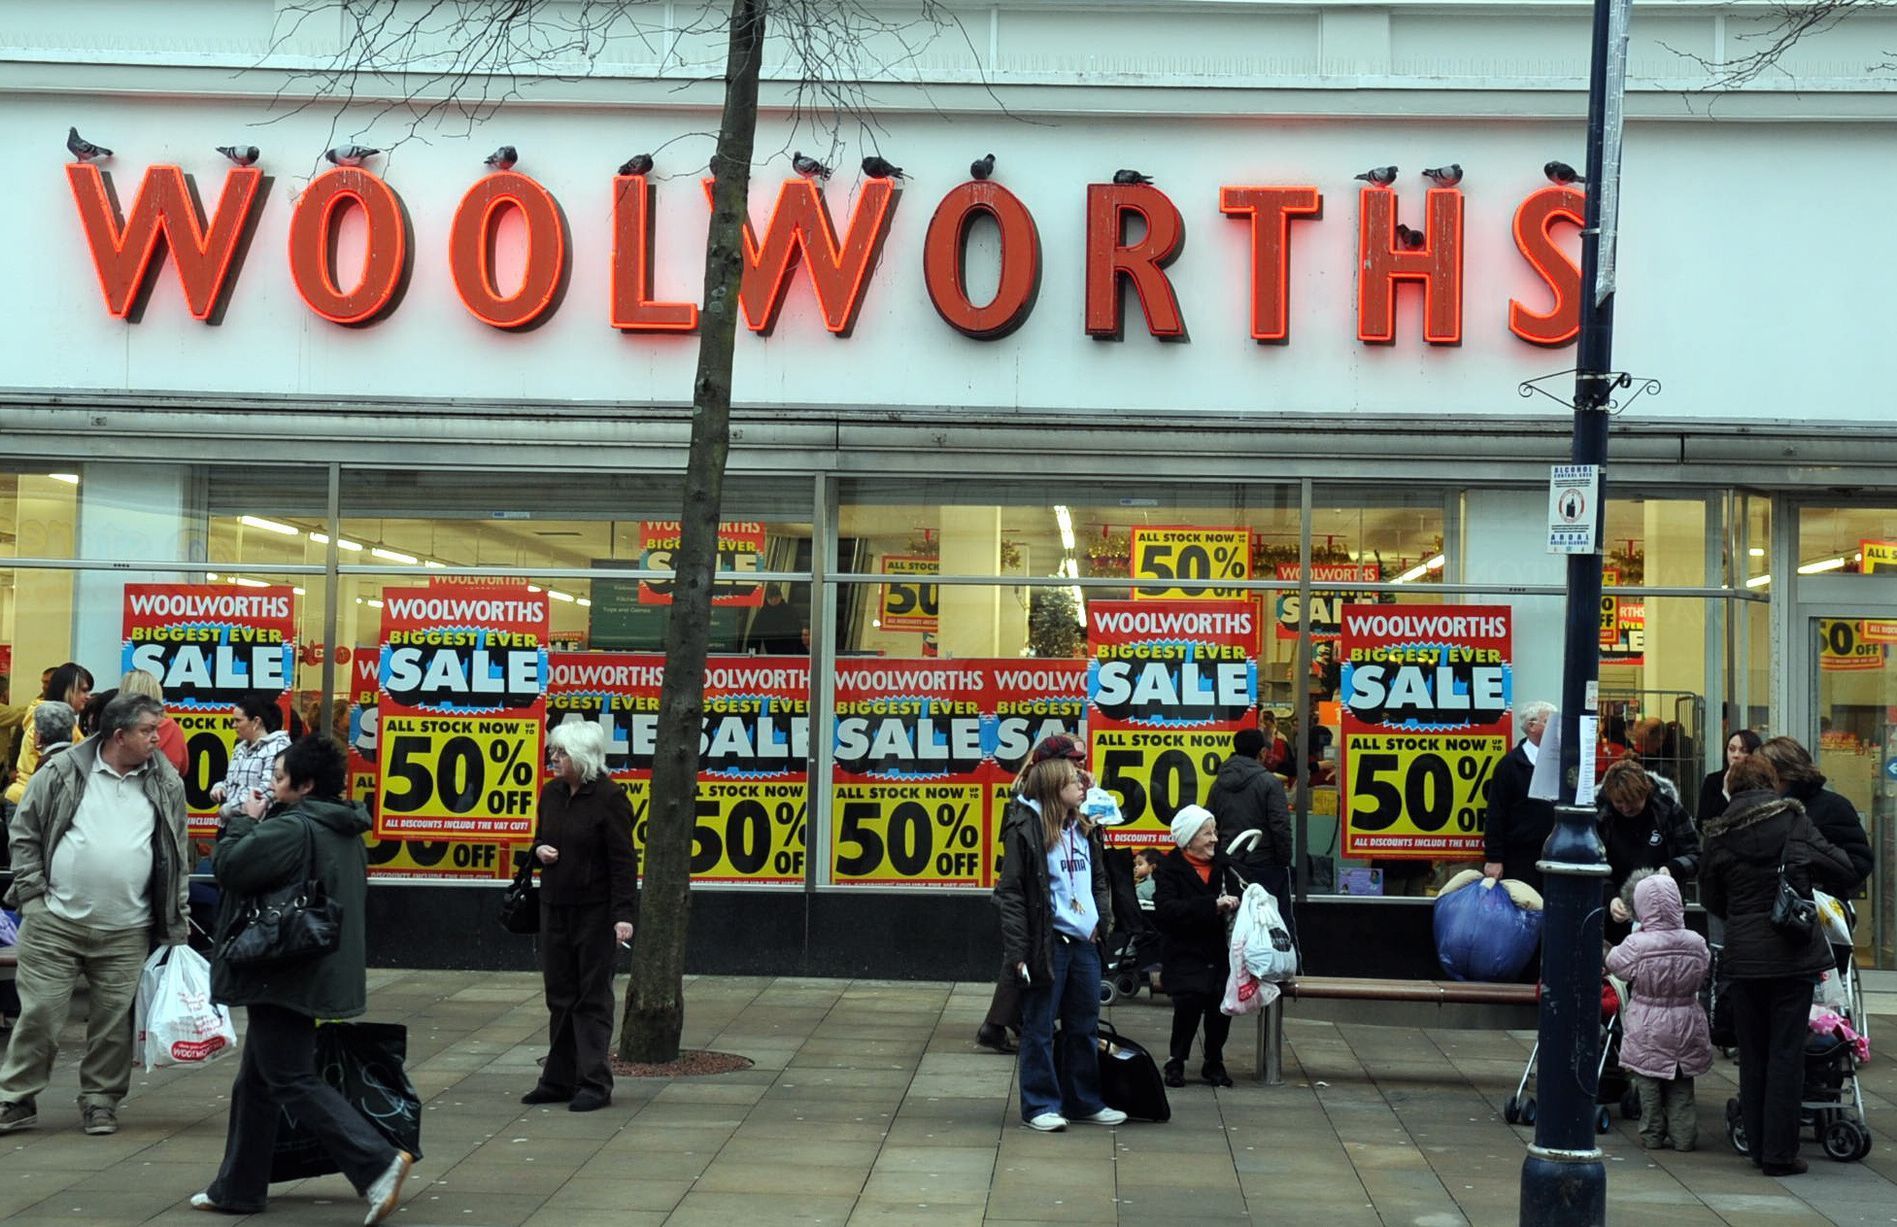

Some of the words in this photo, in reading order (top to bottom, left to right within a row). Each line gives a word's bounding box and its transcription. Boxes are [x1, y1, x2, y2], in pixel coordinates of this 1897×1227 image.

[65, 163, 1586, 346] WOOLWORTHS
[718, 541, 756, 551] EVER
[1138, 533, 1159, 542] ALL
[1163, 534, 1201, 542] STOCK
[1205, 534, 1235, 542] NOW
[1867, 548, 1888, 558] ALL
[1138, 545, 1245, 596] 50%
[130, 594, 289, 618] WOOLWORTHS
[387, 598, 544, 623] WOOLWORTHS
[1094, 612, 1251, 634] WOOLWORTHS
[1347, 615, 1507, 638] WOOLWORTHS
[131, 627, 220, 642] BIGGEST
[229, 629, 283, 643] EVER
[389, 631, 477, 645] BIGGEST
[485, 632, 538, 648] EVER
[1097, 644, 1186, 659] BIGGEST
[1195, 645, 1246, 660] EVER
[1350, 648, 1440, 662] BIGGEST
[1449, 649, 1501, 663] EVER
[132, 643, 285, 689] SALE
[385, 648, 540, 693] SALE
[834, 671, 984, 691] WOOLWORTHS
[994, 671, 1088, 691] WOOLWO
[1094, 661, 1249, 706] SALE
[1348, 665, 1506, 709] SALE
[611, 697, 659, 711] EVER
[769, 700, 809, 713] EVE
[837, 702, 921, 715] BIGGEST
[929, 702, 978, 715] EVER
[996, 702, 1082, 715] BIGGEST
[386, 720, 415, 732] ALL
[420, 720, 472, 734] STOCK
[479, 722, 519, 734] NOW
[834, 718, 982, 760] SALE
[1096, 734, 1126, 746] ALL
[1131, 735, 1184, 746] STOCK
[1190, 735, 1231, 747] NOW
[1351, 738, 1380, 750] ALL
[1386, 739, 1439, 750] STOCK
[1445, 740, 1486, 751] NOW
[356, 777, 374, 787] AL
[383, 736, 533, 814] 50%
[709, 786, 759, 797] STOCK
[765, 786, 804, 797] NOW
[836, 788, 864, 798] ALL
[869, 788, 920, 799] STOCK
[925, 788, 964, 798] NOW
[1351, 753, 1493, 832] 50%
[487, 790, 532, 815] OFF
[385, 820, 398, 828] ALL
[401, 820, 442, 829] DISCOUNTS
[444, 820, 475, 830] INCLUDE
[478, 821, 492, 830] THE
[494, 821, 508, 830] VAT
[510, 822, 529, 831] CUT!
[836, 801, 978, 876] 50%
[1114, 834, 1157, 843] DISCOUNTS
[1354, 838, 1367, 846] ALL
[1370, 838, 1412, 847] DISCOUNTS
[1414, 838, 1446, 847] INCLUDE
[1449, 839, 1464, 847] THE
[1465, 839, 1480, 848] VAT
[453, 844, 496, 867] OFF
[774, 851, 804, 874] OF
[936, 853, 979, 876] OFF
